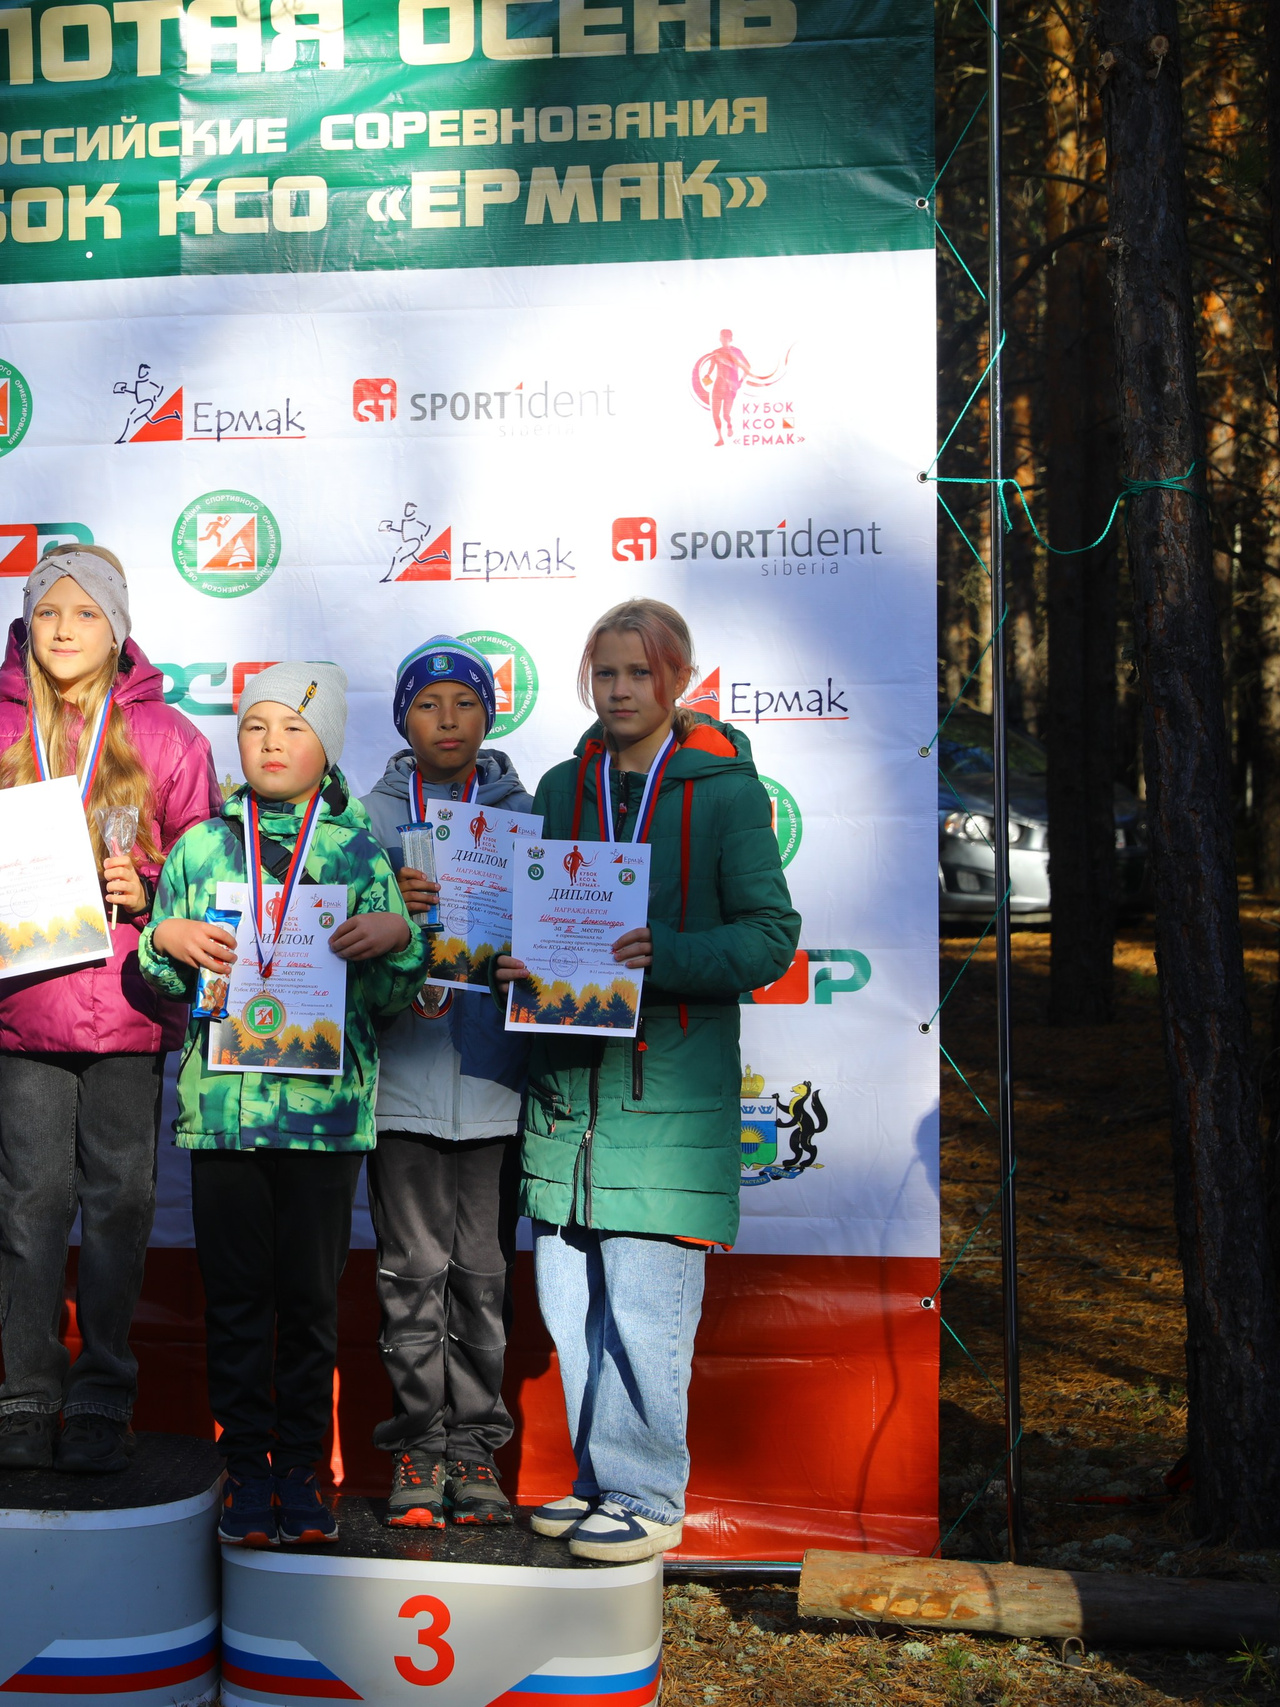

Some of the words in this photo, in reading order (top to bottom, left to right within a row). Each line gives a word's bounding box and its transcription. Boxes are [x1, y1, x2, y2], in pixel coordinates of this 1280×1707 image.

[320, 97, 768, 151] СОРЕВНОВАНИЯ
[158, 175, 327, 237] КСО
[366, 159, 767, 229] «ЕРМАК»
[7, 379, 28, 445] ОРИЕНТИРОВАНИЯ
[193, 398, 306, 441] Ермак
[742, 402, 793, 414] КУБОК
[742, 418, 775, 430] КСО
[177, 504, 202, 546] ФЕДЕРАЦИЯ
[205, 494, 259, 511] СПОРТИВНОГО
[255, 515, 276, 581] ОРИЕНТИРОВАНИЯ
[670, 518, 883, 560] SPORTident
[462, 538, 576, 582] Ермак
[761, 559, 839, 577] siberia
[512, 656, 534, 724] ОРИЕНТИРОВАНИЯ
[731, 678, 848, 724] Ермак
[451, 849, 508, 869] ДИПЛОМ
[548, 888, 613, 902] ДИПЛОМ
[554, 907, 608, 915] НАГРАЖДАЕТСЯ
[393, 1594, 455, 1686] 3
